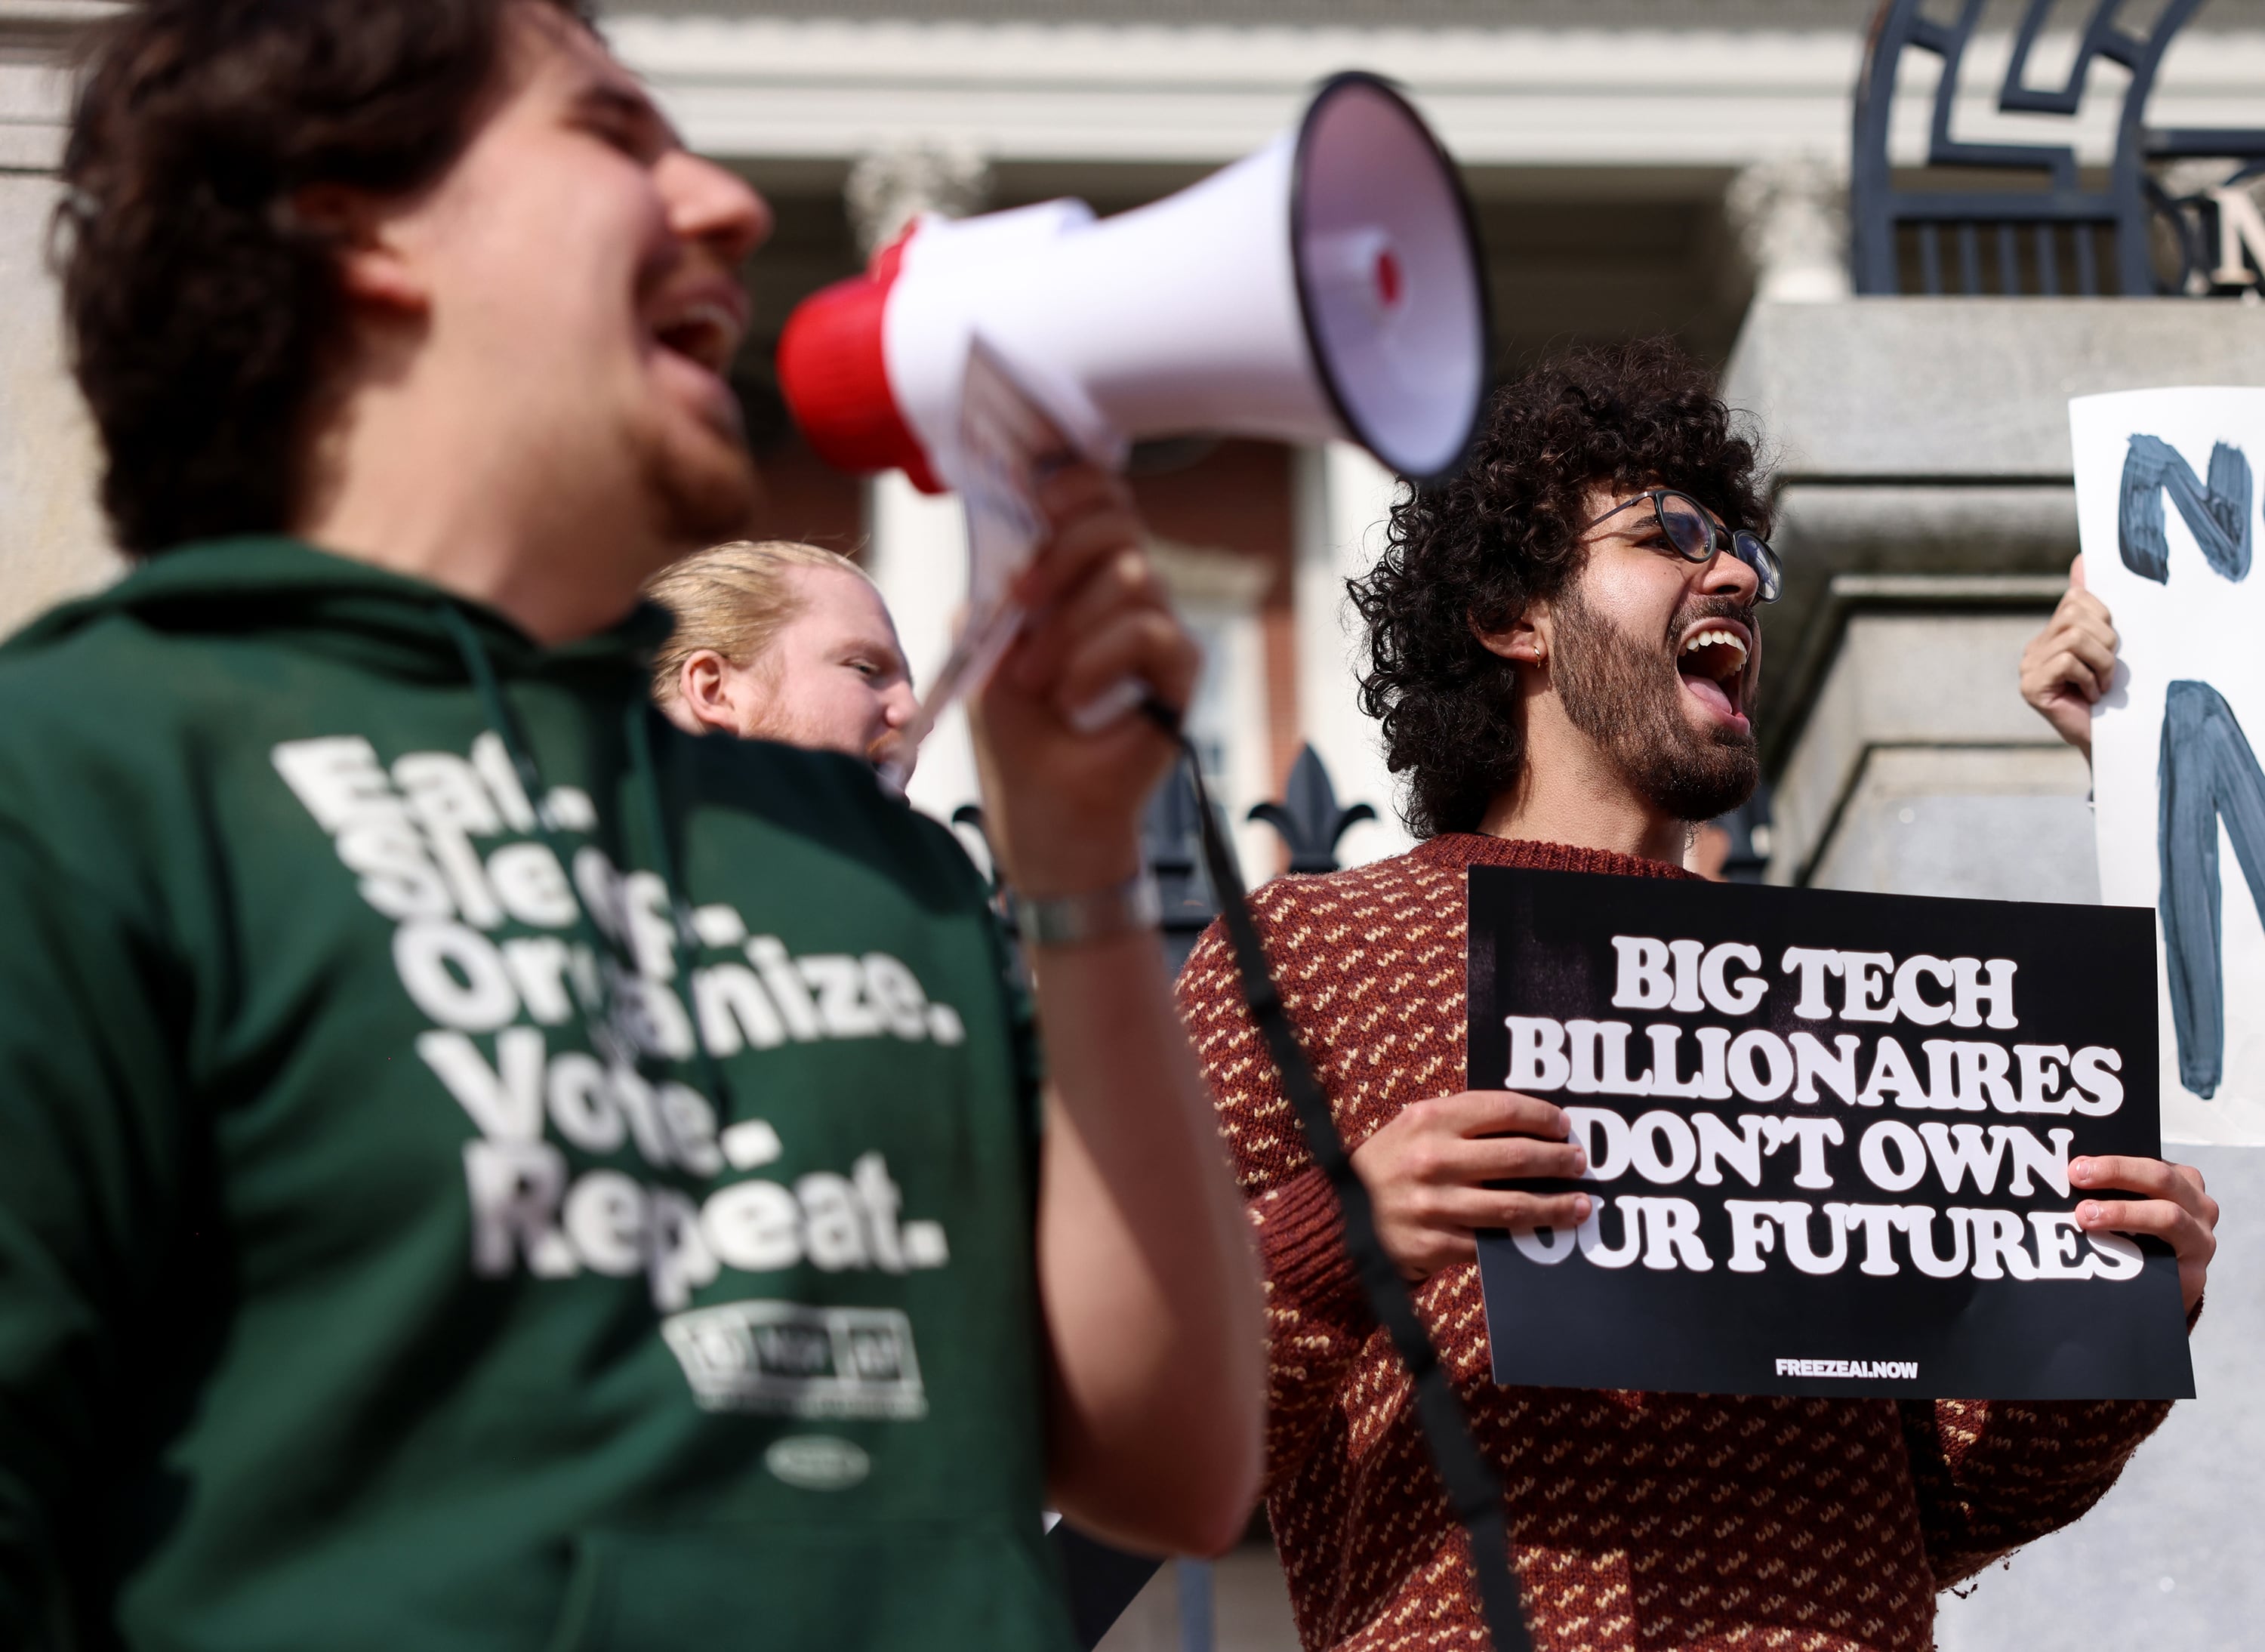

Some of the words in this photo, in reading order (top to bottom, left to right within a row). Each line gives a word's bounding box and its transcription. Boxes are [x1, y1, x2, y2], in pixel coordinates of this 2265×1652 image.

[2119, 432, 2265, 585] N
[392, 921, 966, 1060] Oranize.
[1611, 935, 1769, 1016] BIG
[1781, 946, 2019, 1029] TECH
[1504, 1016, 2124, 1117] BILLIONAIRES
[1561, 1106, 1844, 1189] DON’T
[1859, 1120, 2075, 1199] OWN
[1724, 1198, 2144, 1281] FUTURES
[1775, 1358, 1918, 1379] FREEZEAI.NOW
